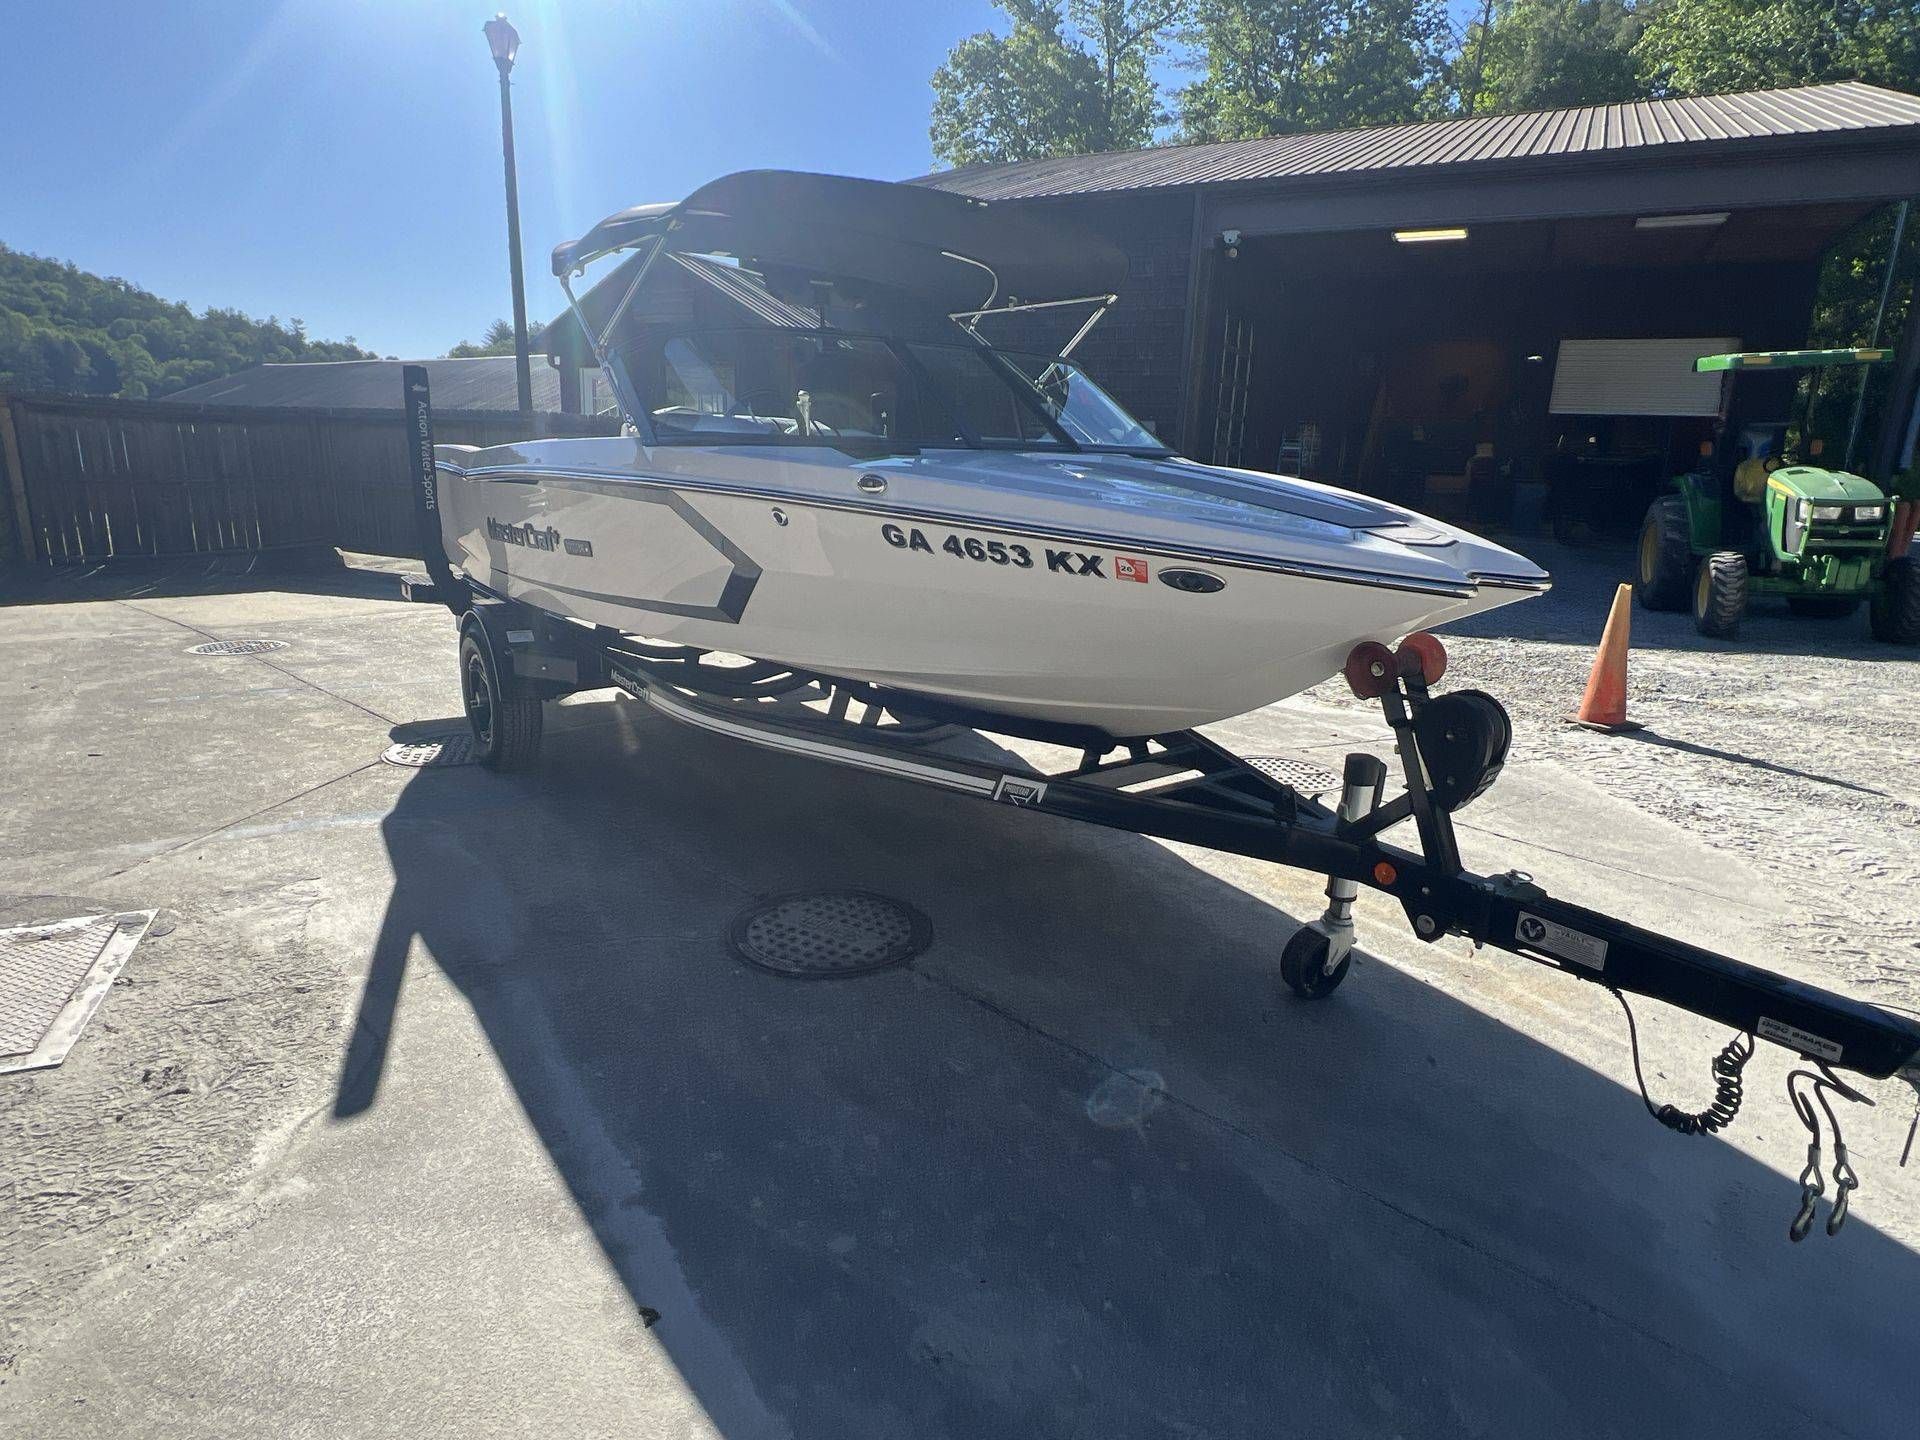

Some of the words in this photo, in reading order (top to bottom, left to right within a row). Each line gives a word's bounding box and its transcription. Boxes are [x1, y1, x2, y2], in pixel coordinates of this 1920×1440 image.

[417, 400, 428, 436] Action
[420, 439, 431, 471] Water
[423, 474, 435, 510] Sports
[487, 516, 561, 552] MasterCraft
[881, 523, 934, 555] GA
[942, 533, 1034, 569] 4653
[1044, 548, 1108, 579] KX
[610, 668, 650, 702] MasterCraft
